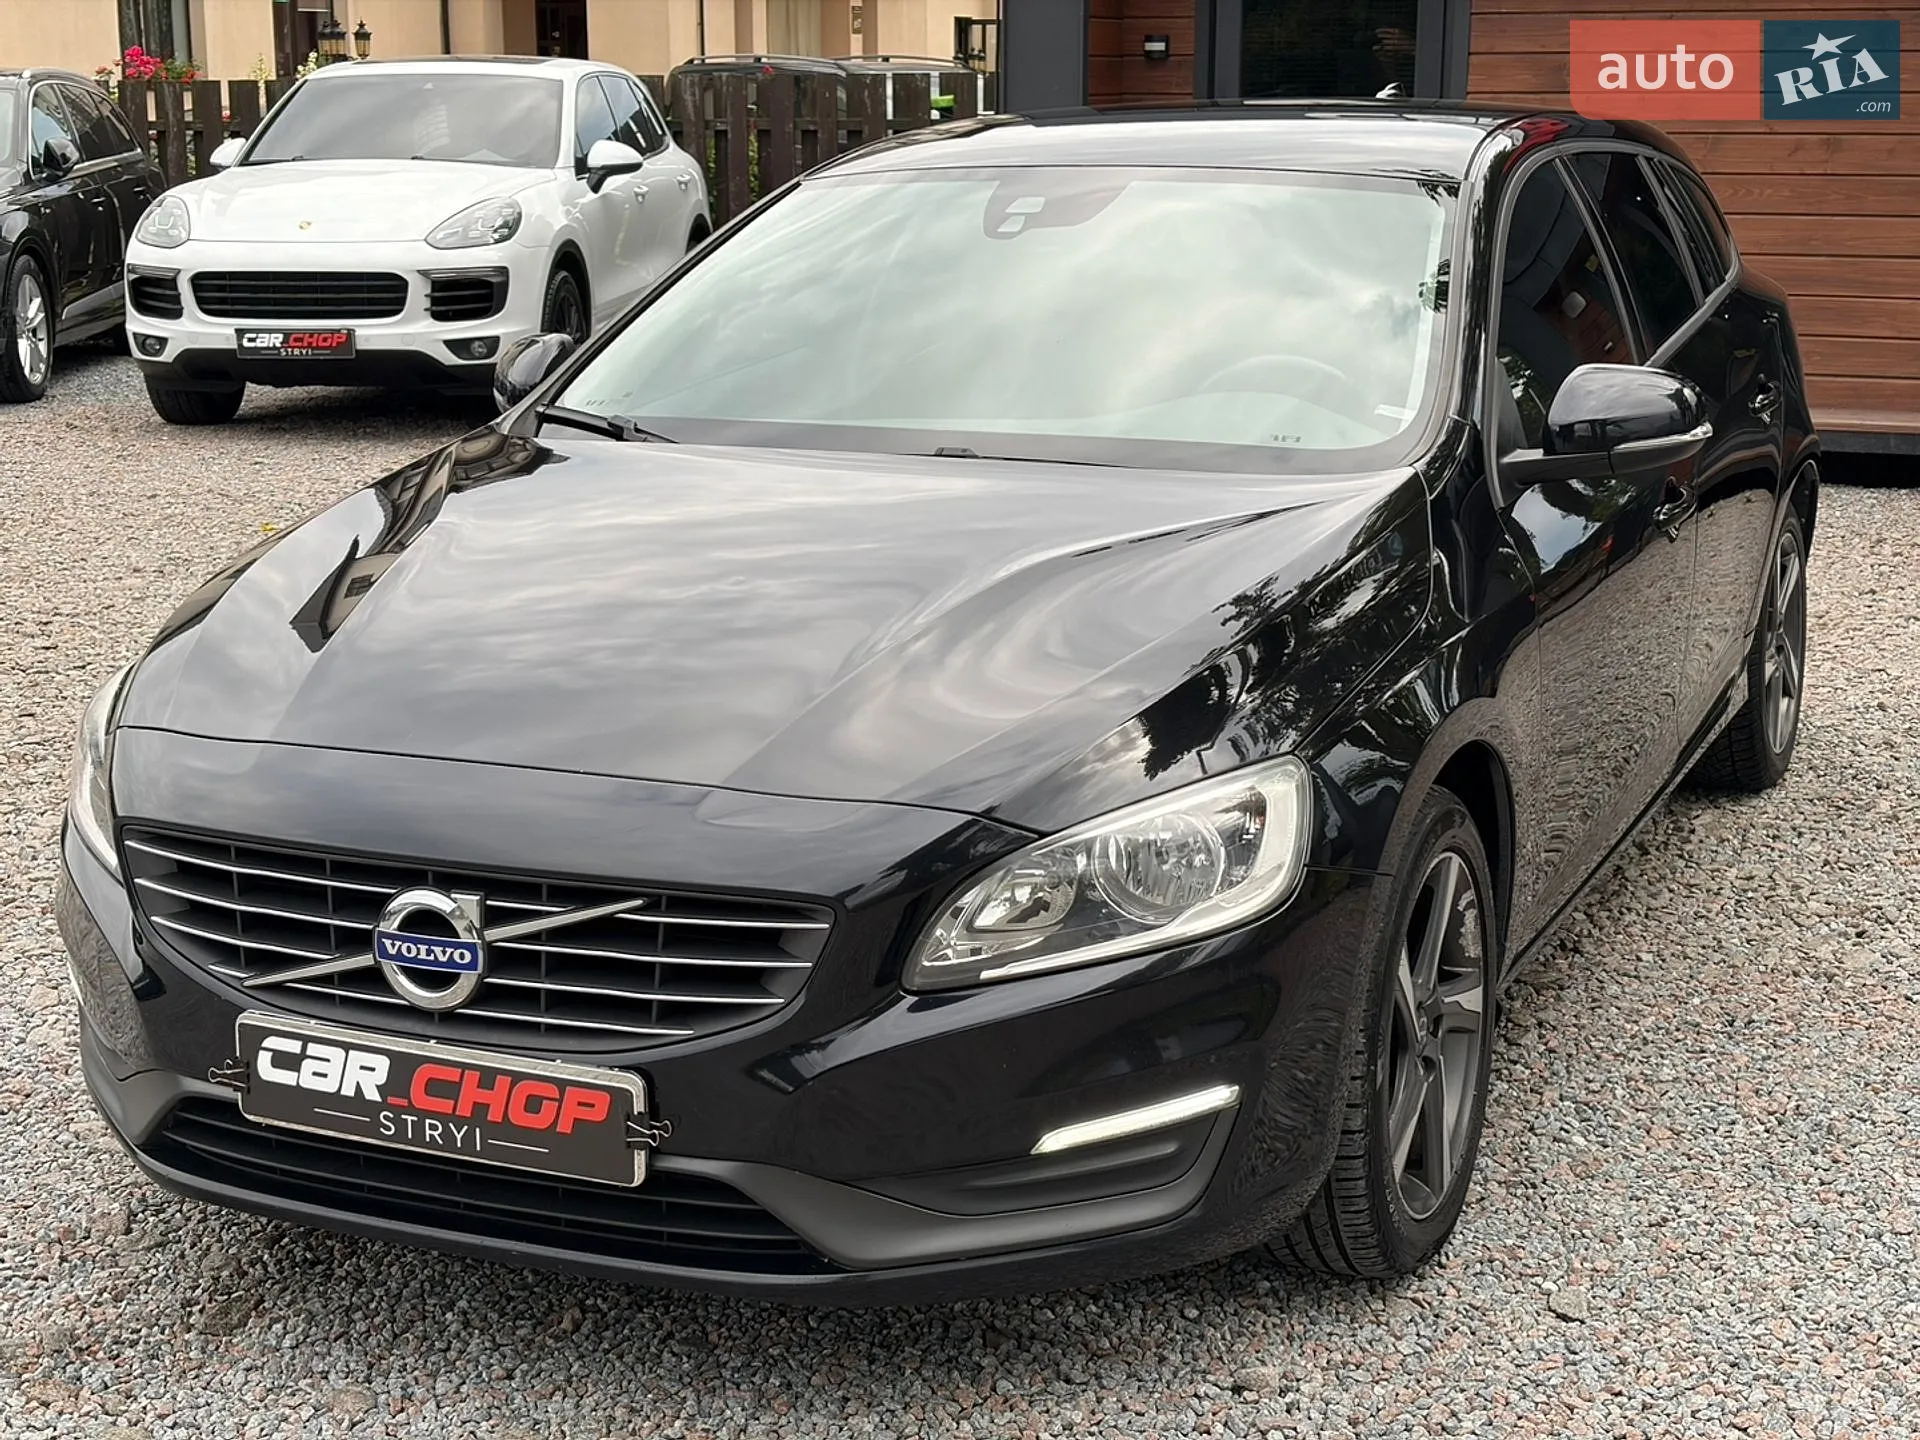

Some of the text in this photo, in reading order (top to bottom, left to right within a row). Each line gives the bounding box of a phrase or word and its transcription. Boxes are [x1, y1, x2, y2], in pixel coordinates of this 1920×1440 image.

[280, 348, 312, 356] STRYI
[381, 938, 472, 964] VOLVO
[379, 1110, 481, 1151] STRYI
